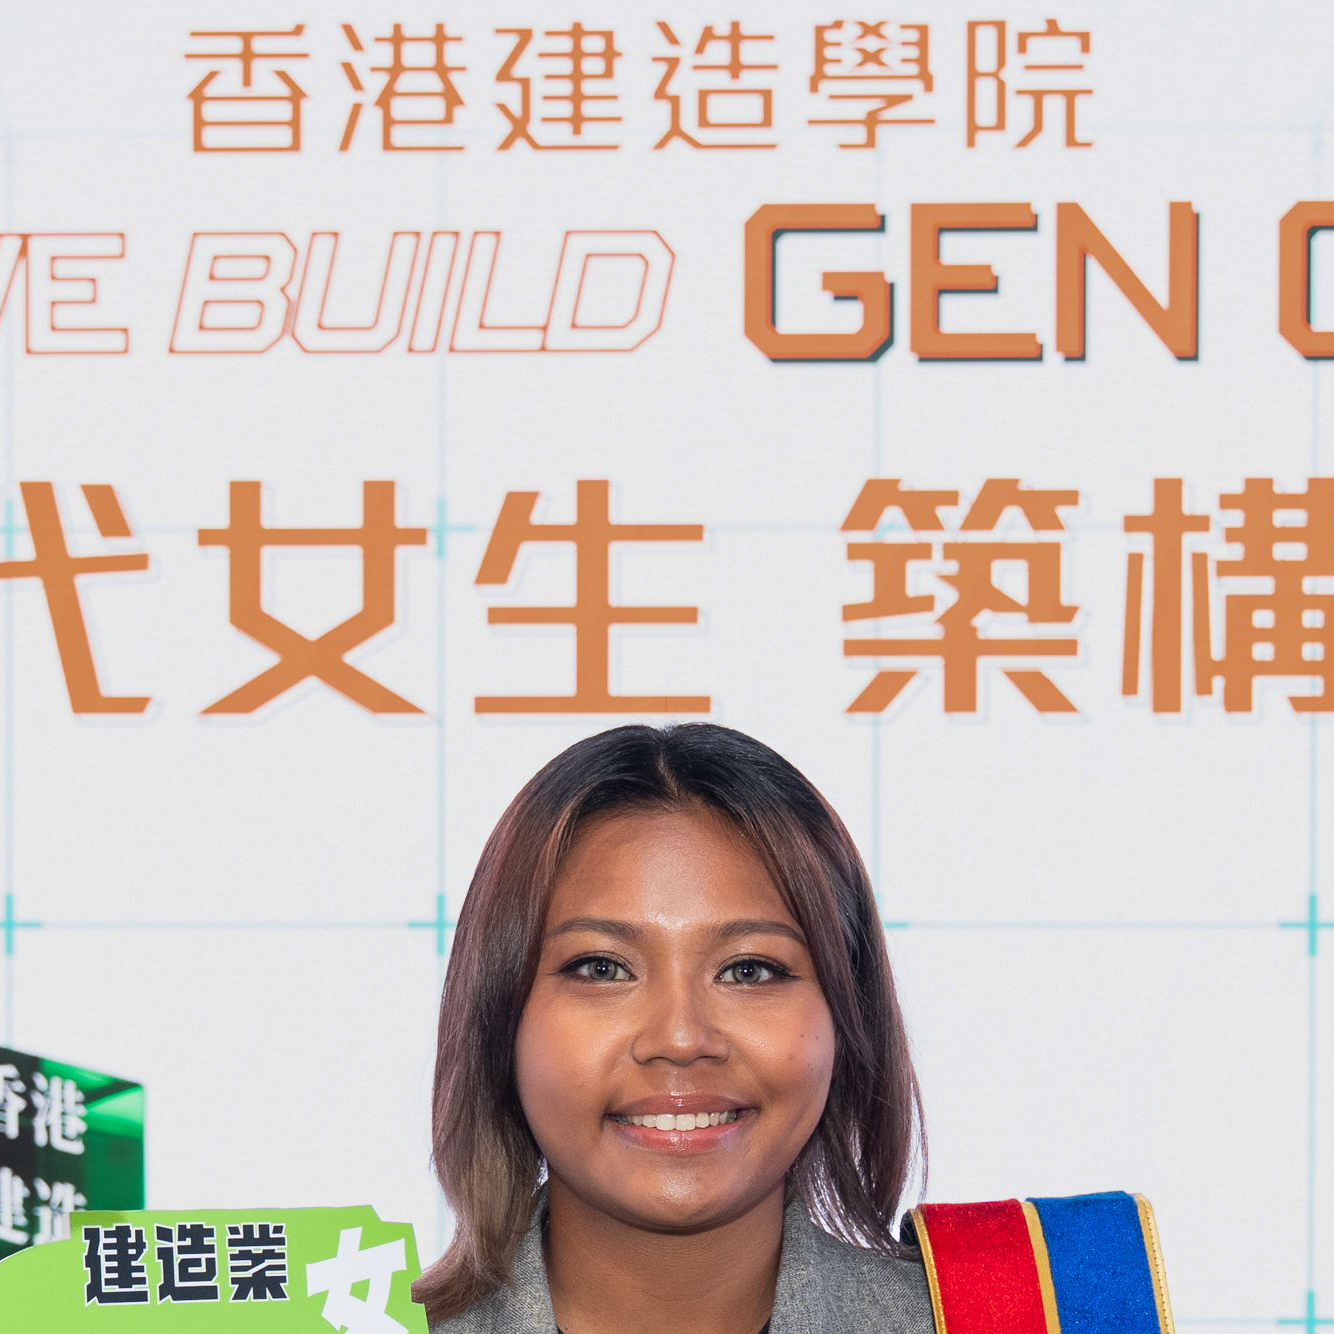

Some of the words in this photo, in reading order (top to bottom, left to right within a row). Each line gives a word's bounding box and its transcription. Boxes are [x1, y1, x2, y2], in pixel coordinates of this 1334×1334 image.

[183, 18, 1094, 154] 香港建造學院
[167, 229, 677, 355] BUILD
[742, 200, 1200, 363] GEN
[82, 1222, 289, 1306] 建造業
